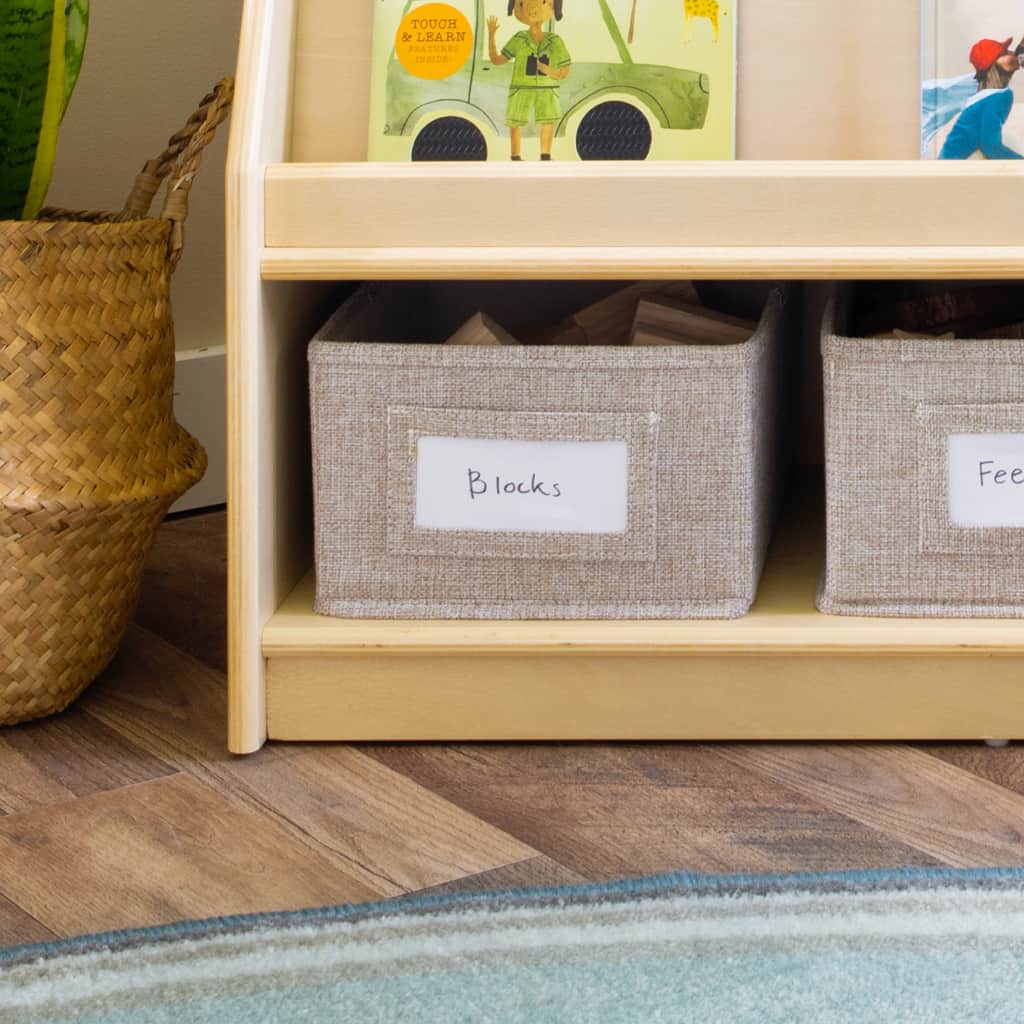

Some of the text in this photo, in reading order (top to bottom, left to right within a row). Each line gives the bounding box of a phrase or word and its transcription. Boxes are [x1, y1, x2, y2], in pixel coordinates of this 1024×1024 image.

[410, 18, 458, 30] TOUCH
[401, 31, 467, 42] & LEARN
[467, 467, 562, 500] Blocks
